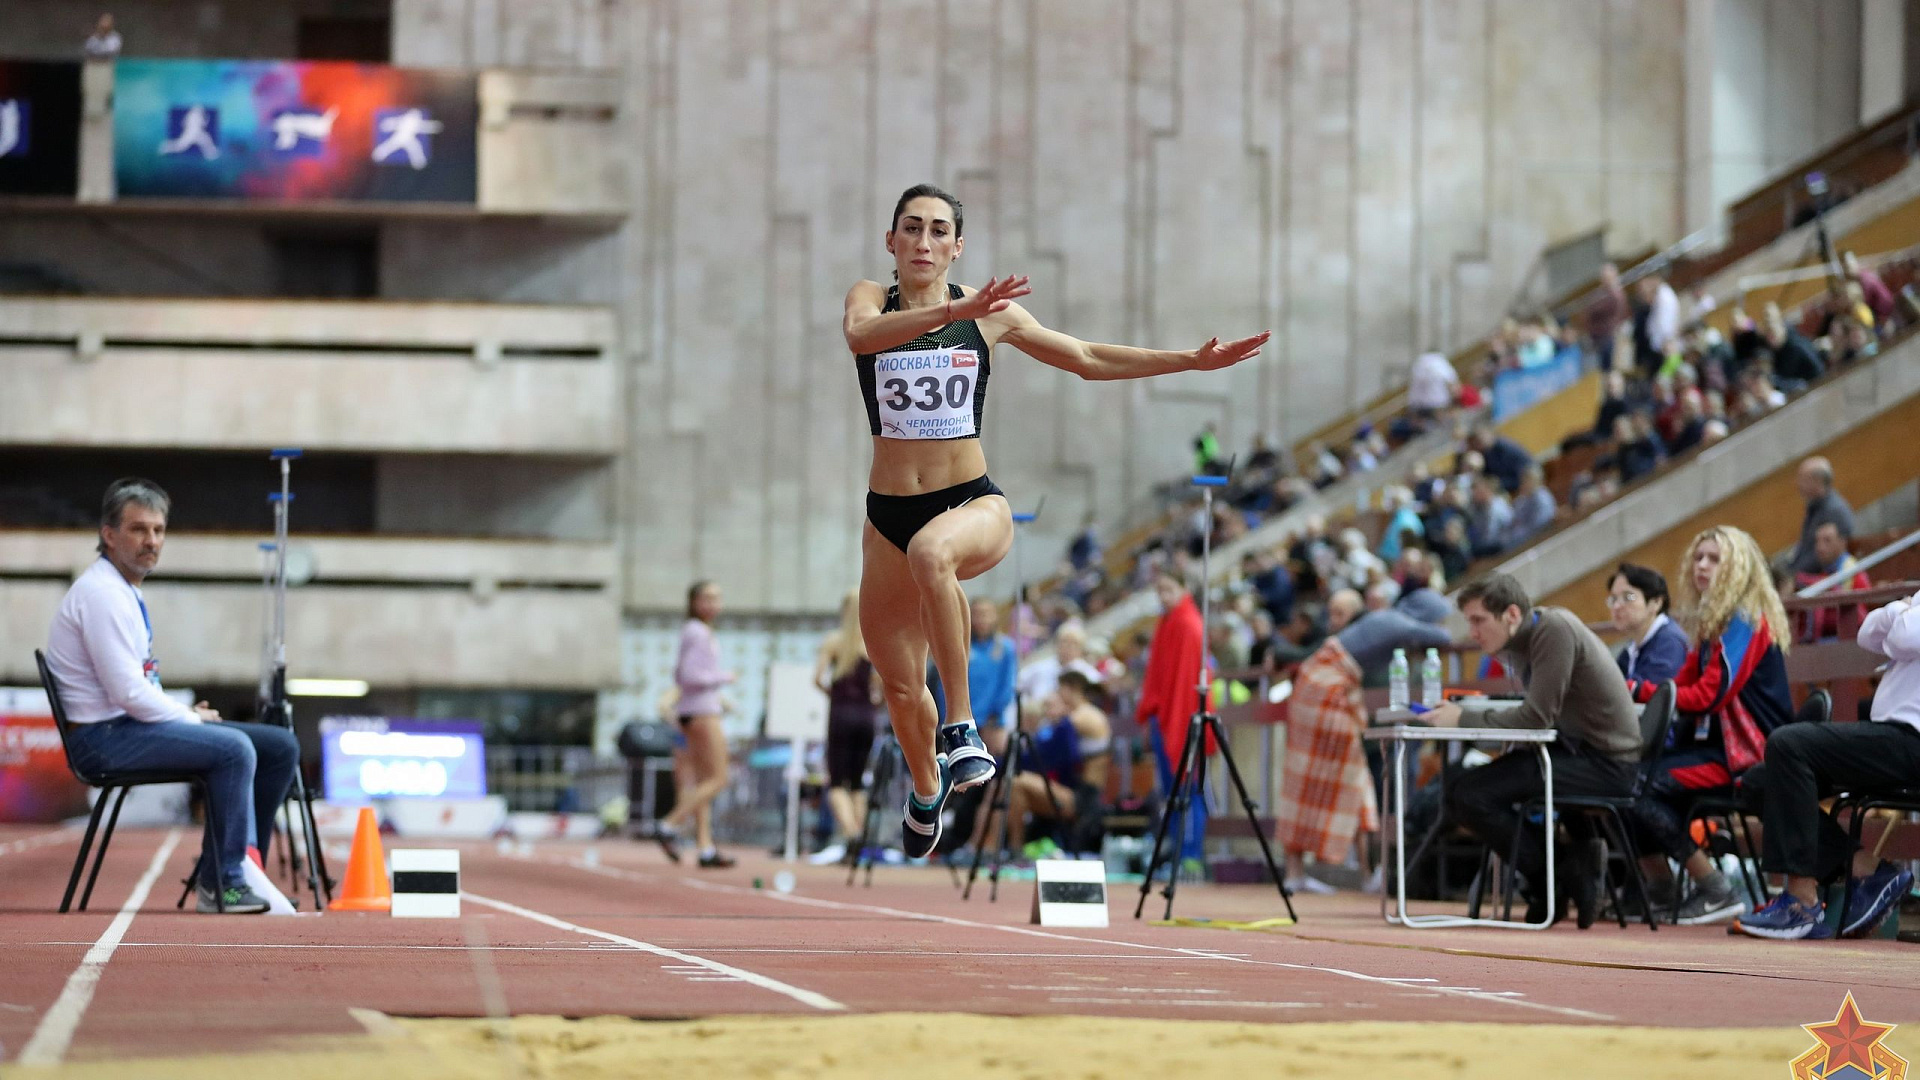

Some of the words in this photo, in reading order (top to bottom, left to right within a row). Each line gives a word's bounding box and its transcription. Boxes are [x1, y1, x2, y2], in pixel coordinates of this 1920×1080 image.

[878, 355, 950, 372] МОСКВА'19
[884, 374, 970, 411] 330
[906, 414, 971, 428] ЧЕМПИОНАТ
[919, 426, 962, 437] РОССИИ
